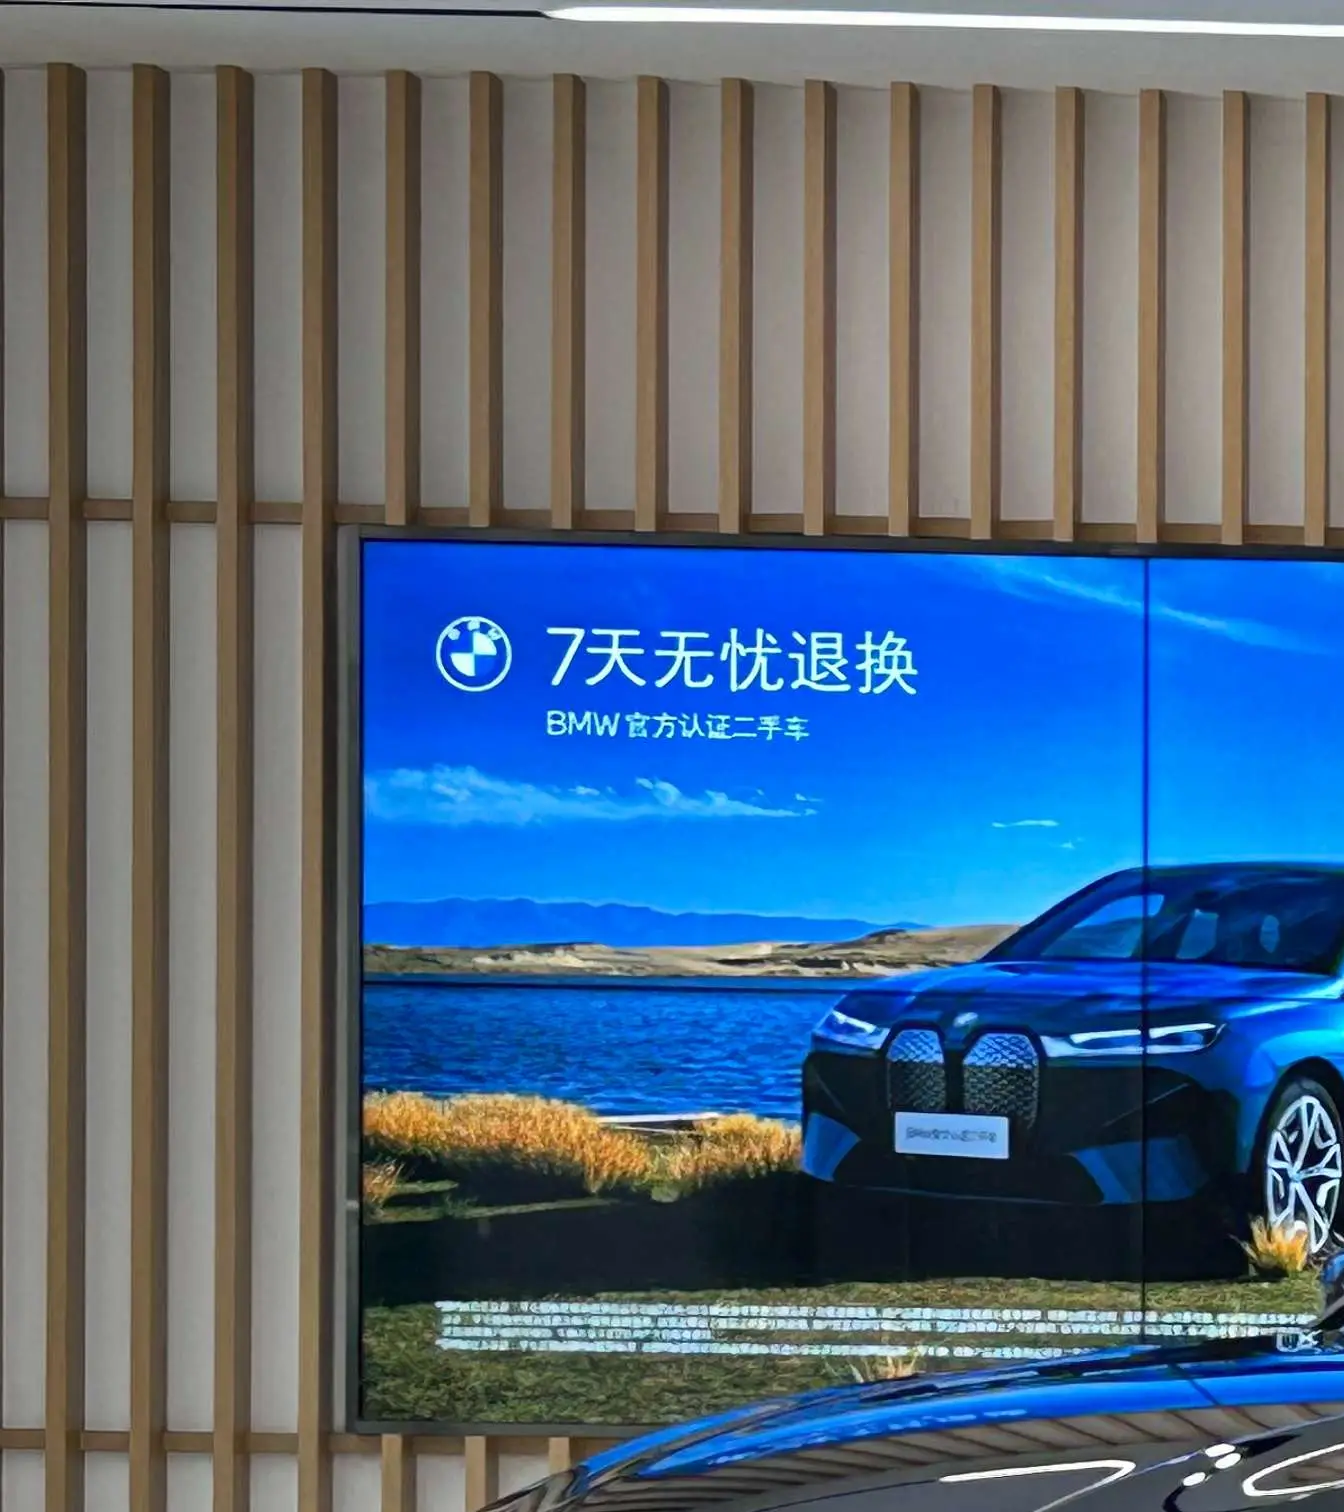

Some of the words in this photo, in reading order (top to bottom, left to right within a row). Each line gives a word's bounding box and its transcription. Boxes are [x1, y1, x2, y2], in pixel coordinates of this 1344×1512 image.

[545, 626, 919, 695] 7天无忧退换
